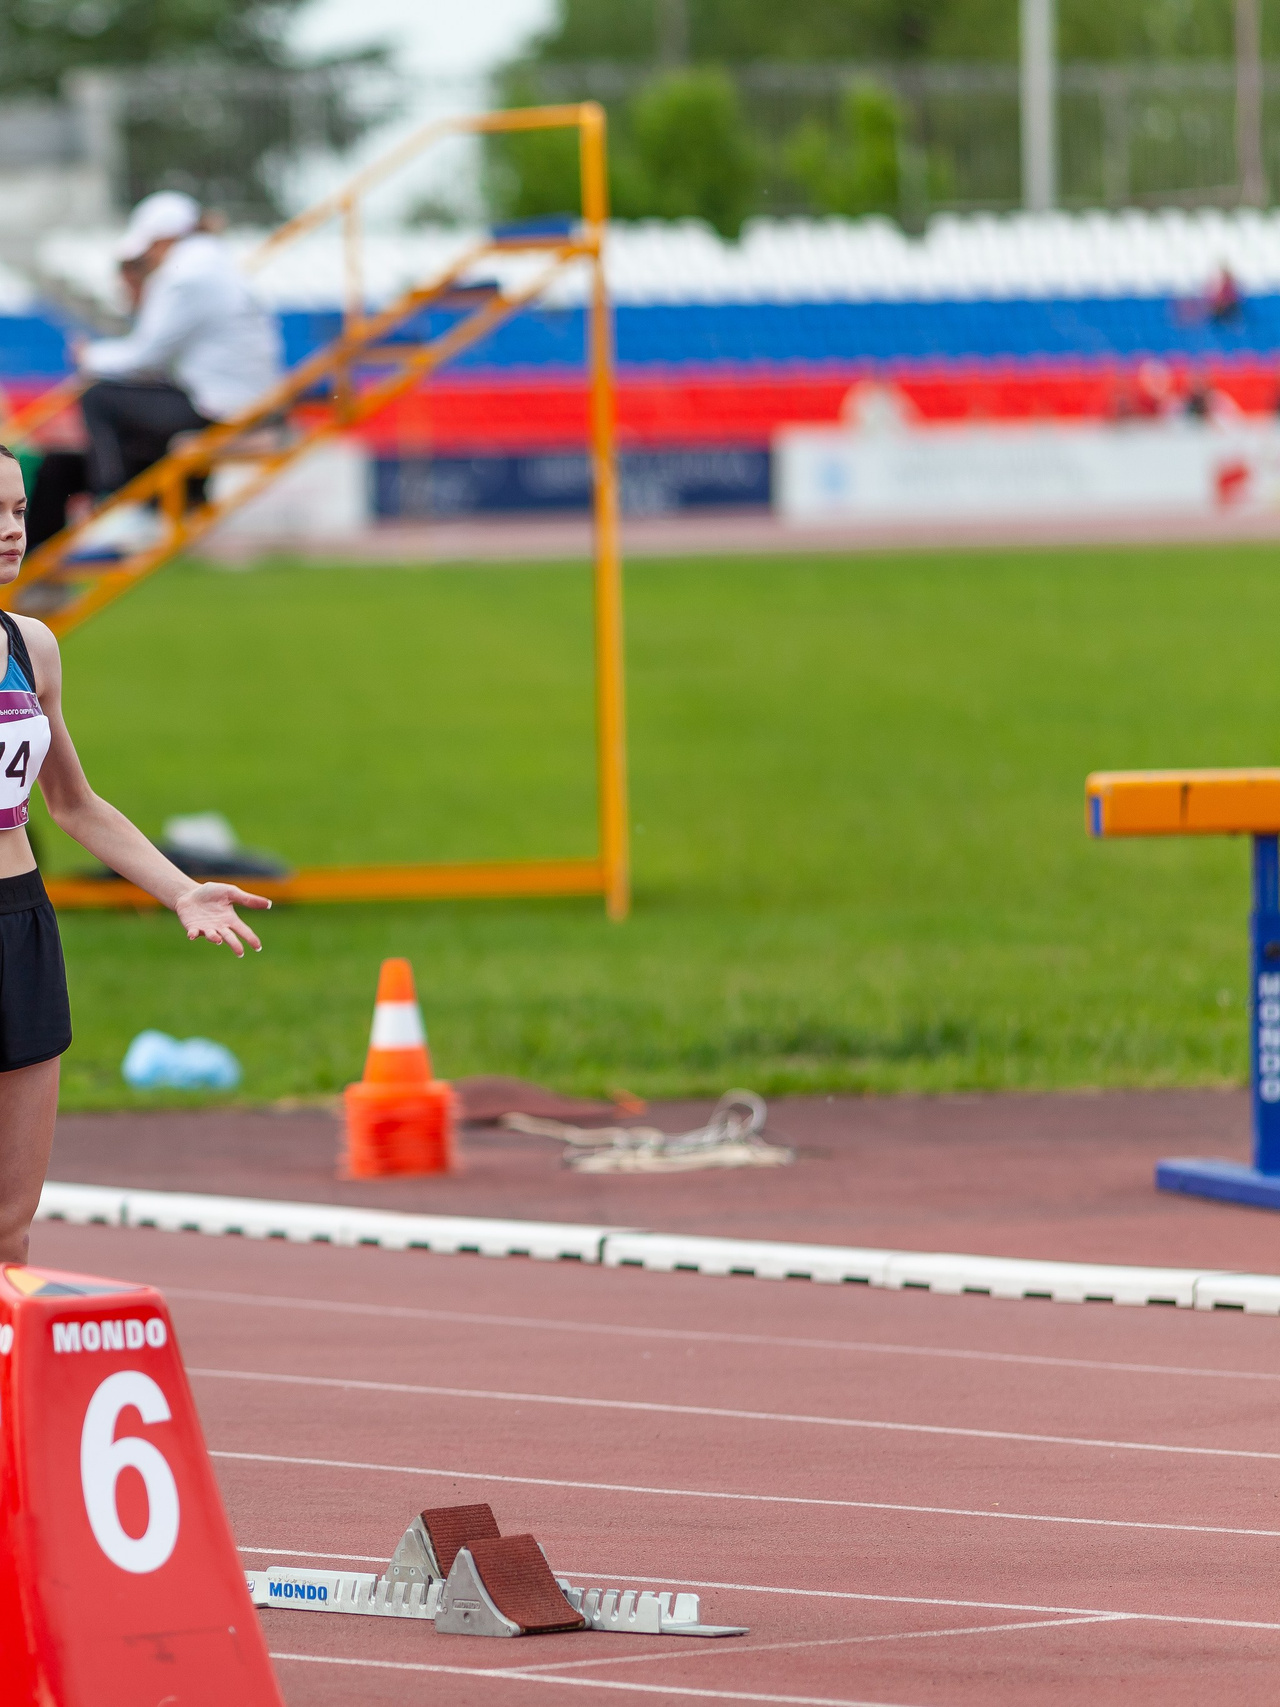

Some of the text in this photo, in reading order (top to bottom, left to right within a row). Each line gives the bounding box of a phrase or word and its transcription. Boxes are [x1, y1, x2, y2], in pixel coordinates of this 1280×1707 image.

[53, 1318, 167, 1353] MONDO
[80, 1369, 180, 1574] 6
[269, 1582, 328, 1601] MONDO
